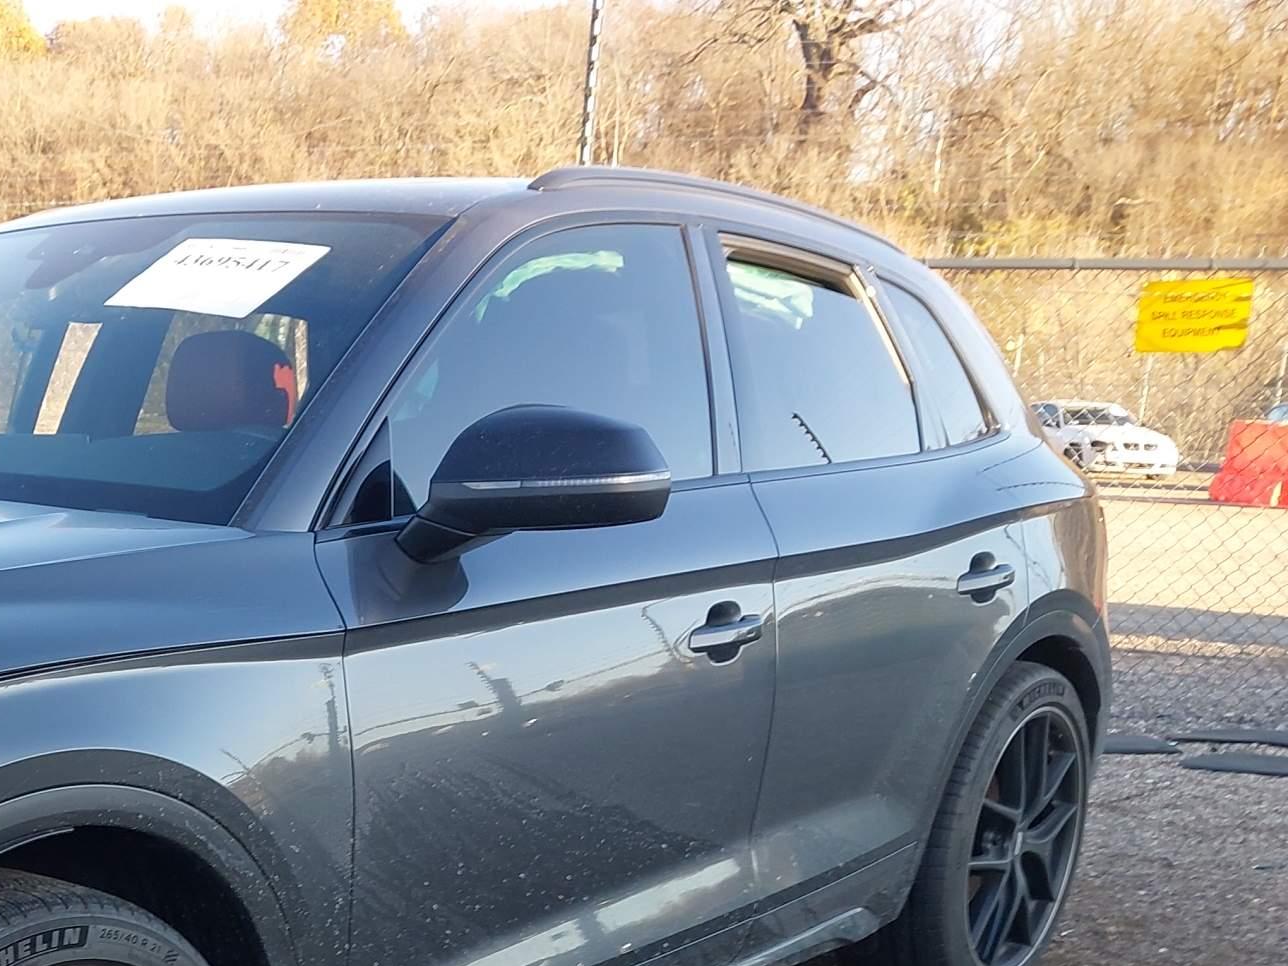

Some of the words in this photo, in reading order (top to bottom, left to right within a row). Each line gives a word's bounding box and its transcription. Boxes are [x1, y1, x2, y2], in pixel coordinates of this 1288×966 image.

[1151, 310, 1177, 321] SPILL
[1181, 308, 1238, 320] RESPONSE
[1162, 327, 1220, 338] EQUIPMENT
[99, 928, 138, 944] 265/40
